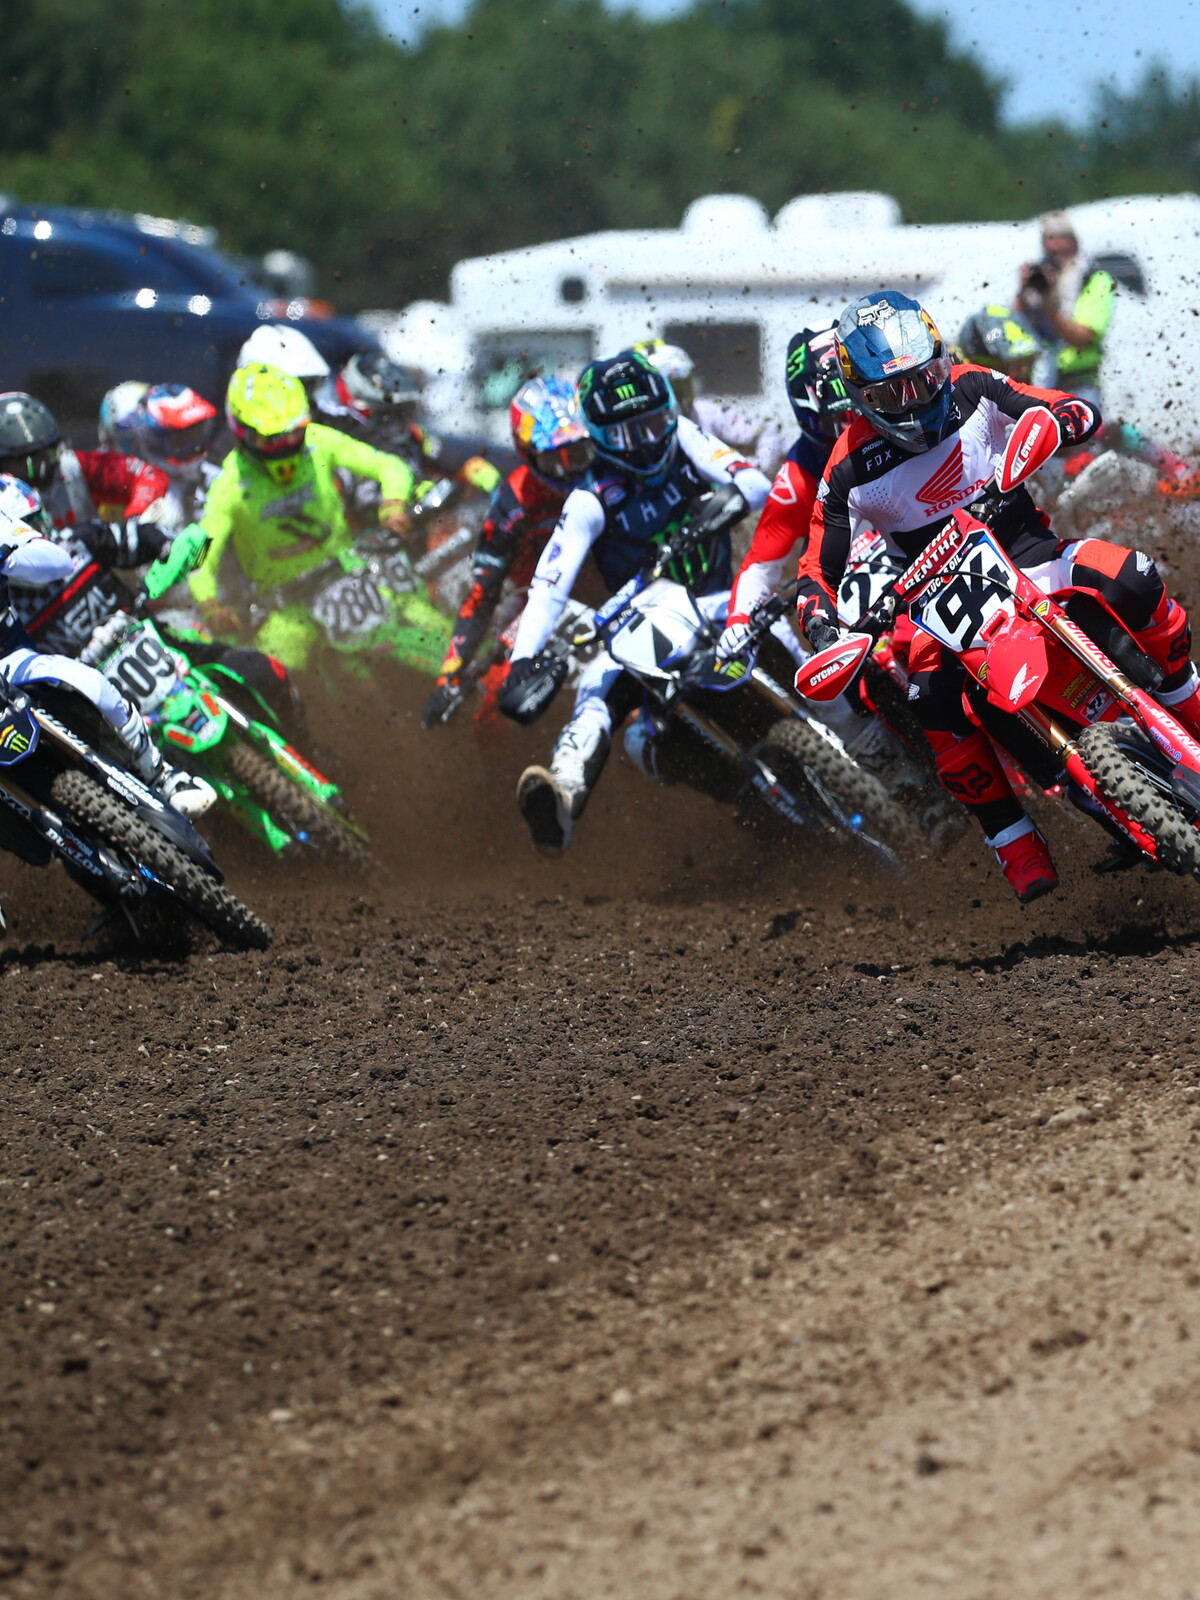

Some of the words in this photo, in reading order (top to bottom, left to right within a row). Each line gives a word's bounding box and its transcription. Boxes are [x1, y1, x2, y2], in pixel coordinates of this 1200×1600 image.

[1020, 423, 1042, 459] CYCRA
[865, 450, 892, 472] FOX
[924, 478, 988, 518] HONDA
[904, 528, 961, 591] RENTHA
[949, 552, 963, 571] OIL
[935, 550, 1011, 651] 94
[981, 610, 1002, 635] HONDA
[809, 660, 841, 687] CYCRA
[1013, 675, 1041, 706] HONDA
[1081, 784, 1139, 844] DUNLOP
[45, 826, 104, 877] DUNLOP
